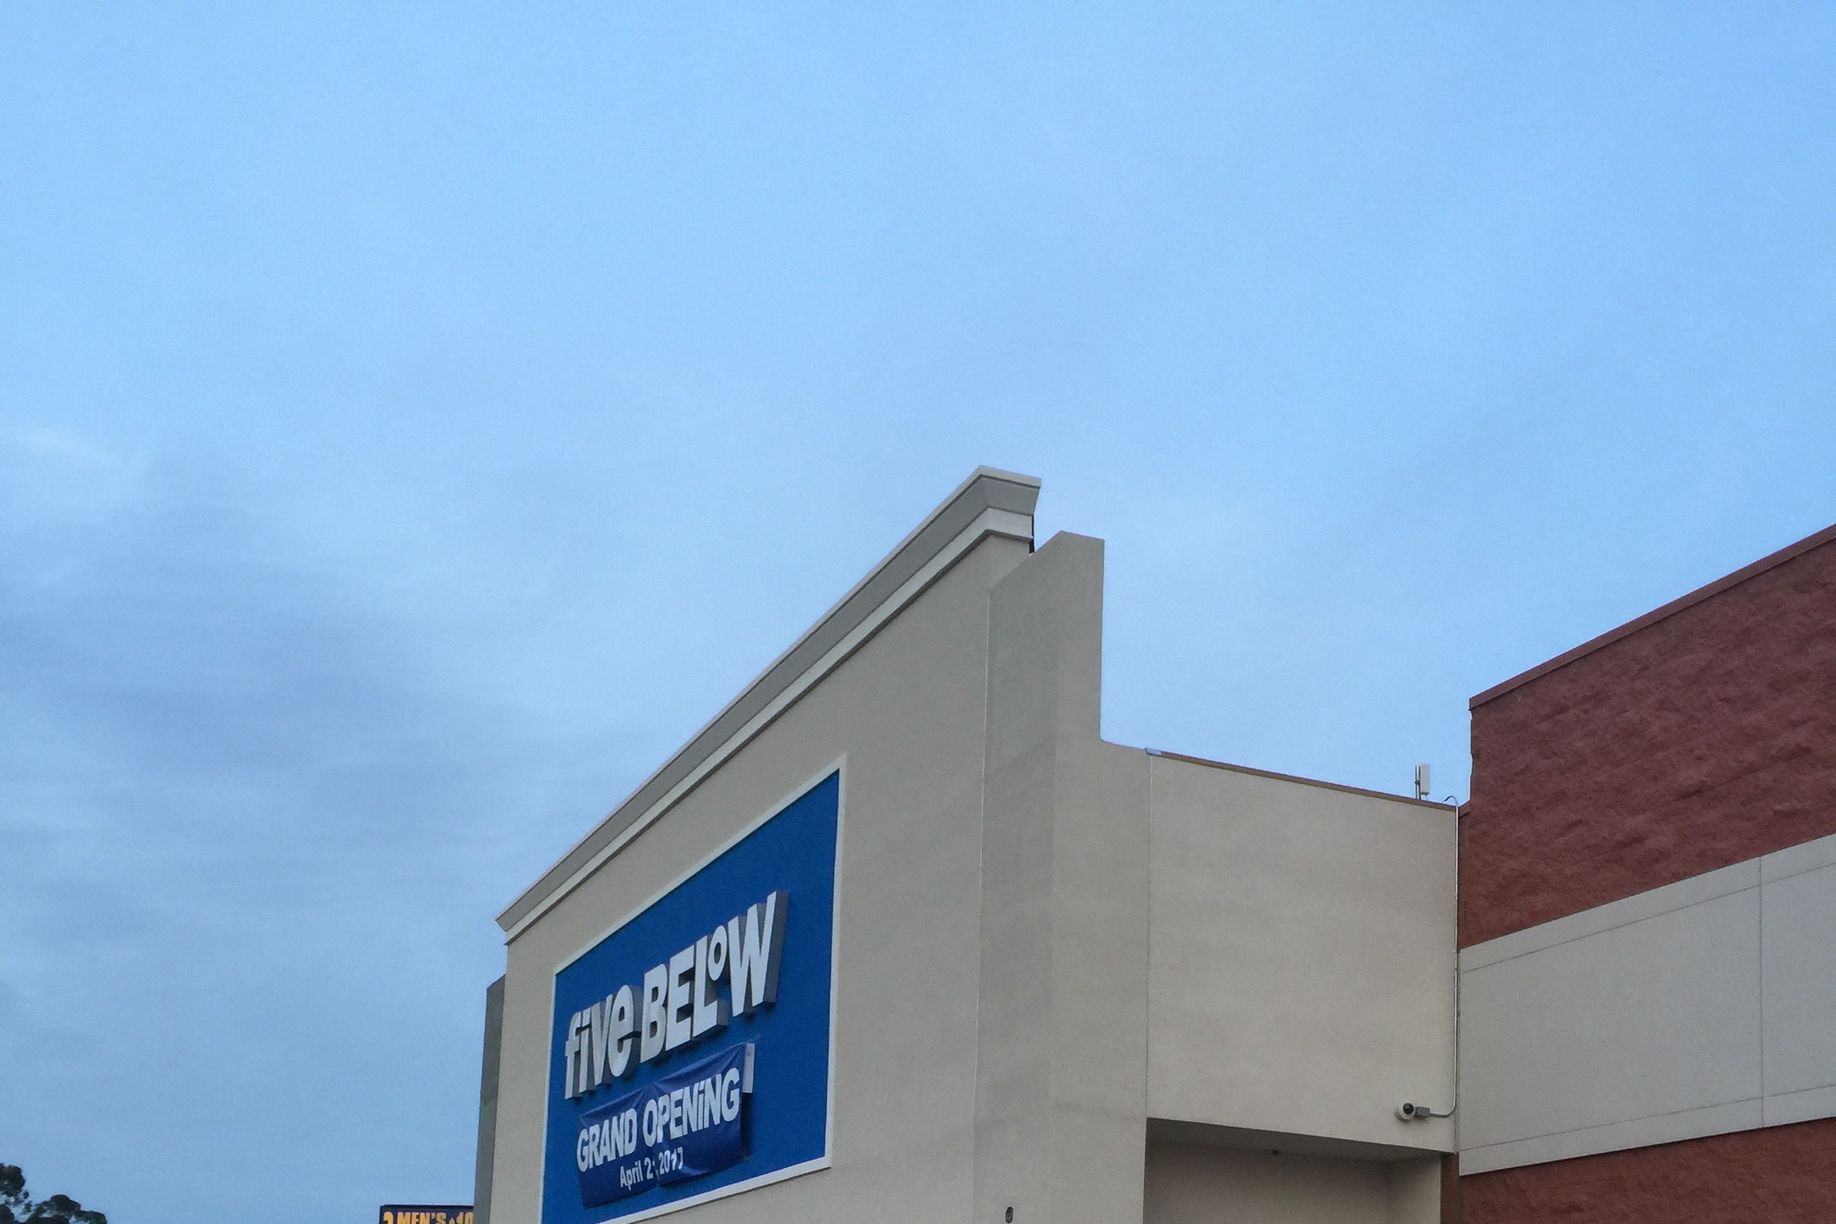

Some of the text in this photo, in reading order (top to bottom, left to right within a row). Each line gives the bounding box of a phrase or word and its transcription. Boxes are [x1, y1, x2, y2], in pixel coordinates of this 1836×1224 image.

[564, 984, 636, 1100] five
[576, 1108, 638, 1173] GRAND
[619, 1160, 644, 1191] April
[658, 1147, 684, 1175] 2017
